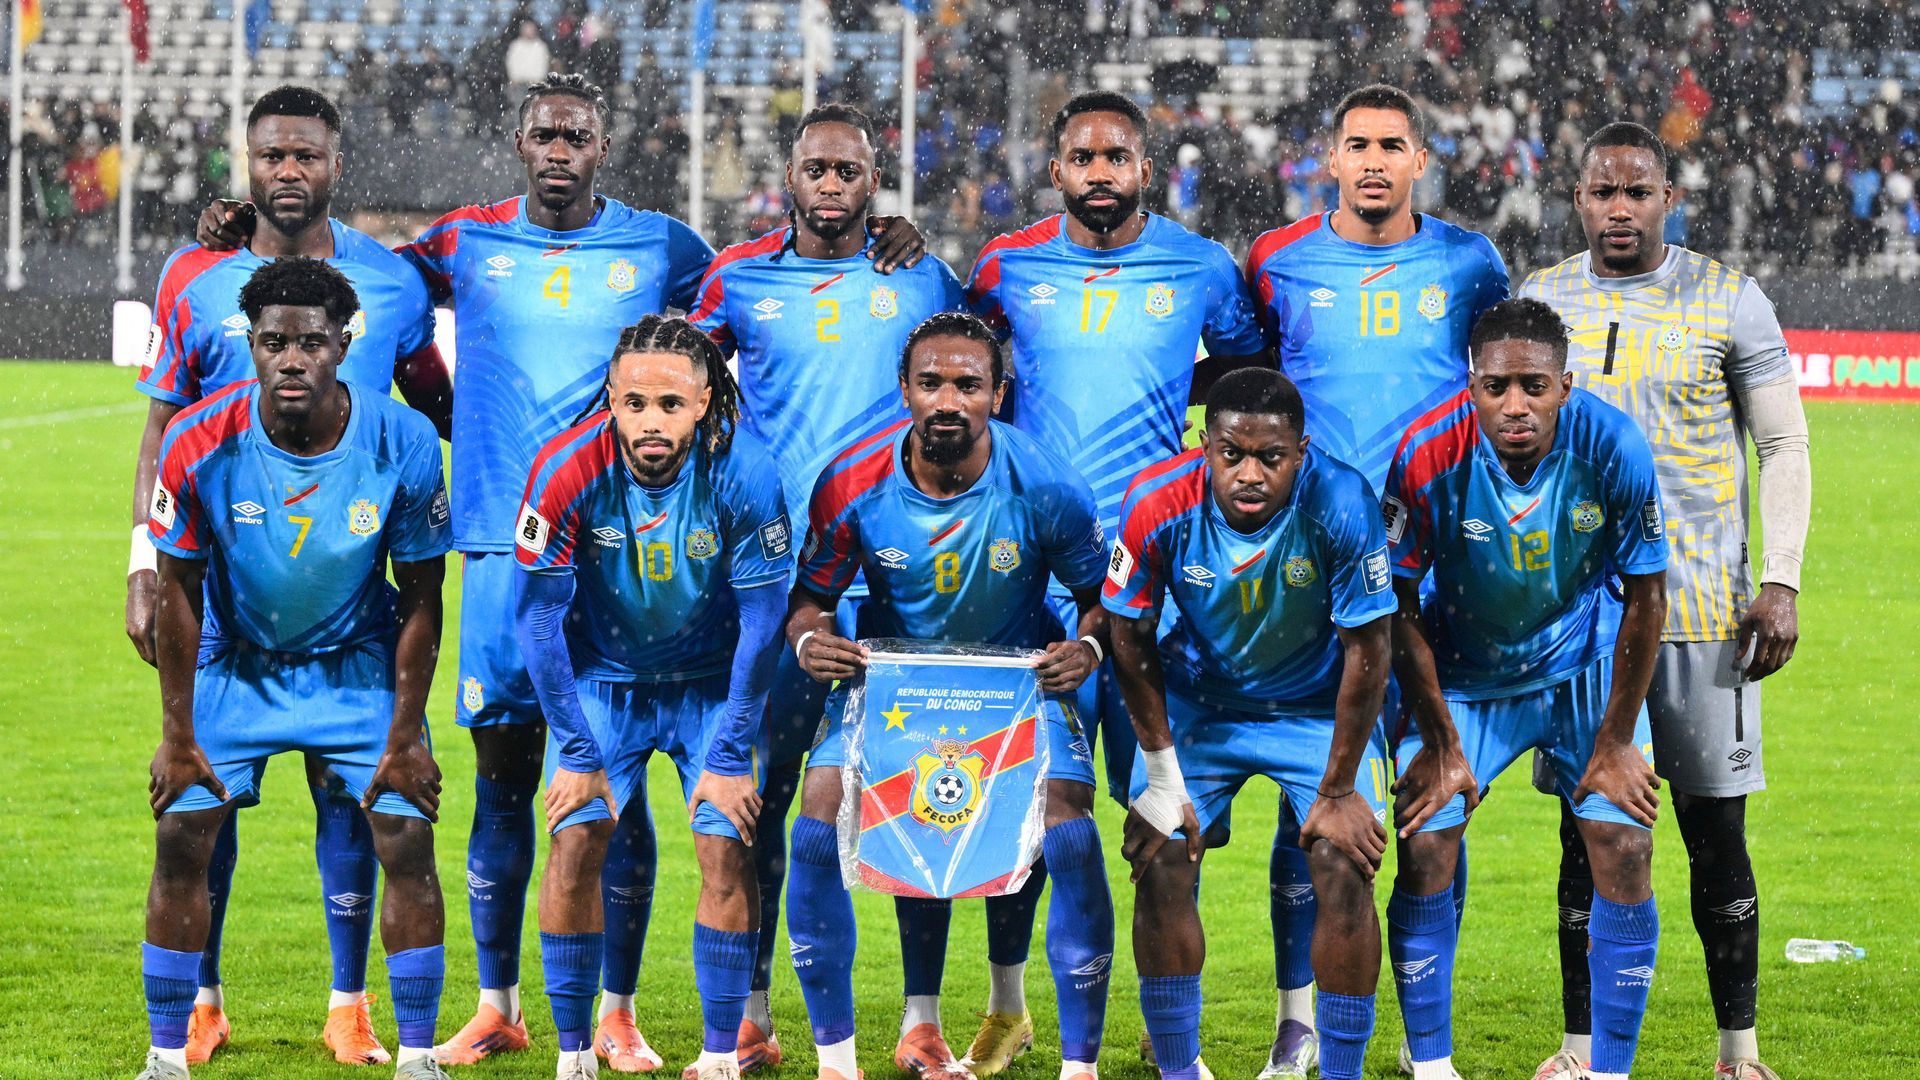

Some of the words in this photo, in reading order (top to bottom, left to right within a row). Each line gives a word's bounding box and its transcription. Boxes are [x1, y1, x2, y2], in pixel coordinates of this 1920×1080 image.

[487, 268, 512, 277] umbro
[543, 265, 571, 309] 4
[1031, 297, 1056, 305] umbro
[756, 312, 782, 321] umbro
[1079, 288, 1119, 333] 17
[1359, 290, 1400, 336] 18
[816, 299, 840, 343] 2
[225, 329, 247, 338] umbr
[1602, 322, 1619, 375] 1
[1834, 355, 1900, 388] FAN
[234, 515, 263, 525] umbro
[288, 515, 313, 559] 7
[766, 529, 786, 541] UNITES
[1463, 533, 1490, 543] umbro
[594, 538, 621, 549] umbro
[1509, 530, 1551, 571] 12
[636, 538, 673, 581] 10
[880, 561, 908, 570] umbro
[1369, 559, 1387, 573] UNITES
[935, 552, 960, 594] 8
[1184, 577, 1212, 588] umbro
[1239, 578, 1263, 615] 11
[896, 688, 949, 697] REPUBLIQUE
[950, 689, 1015, 699] DEMOCRATIQUE
[926, 698, 942, 710] DU
[944, 699, 982, 712] CONGO
[923, 805, 973, 824] FECOFA
[469, 888, 492, 901] bro
[331, 908, 368, 917] umbro
[792, 957, 813, 968] bro
[1075, 972, 1110, 989] umbr
[1616, 979, 1650, 988] umb
